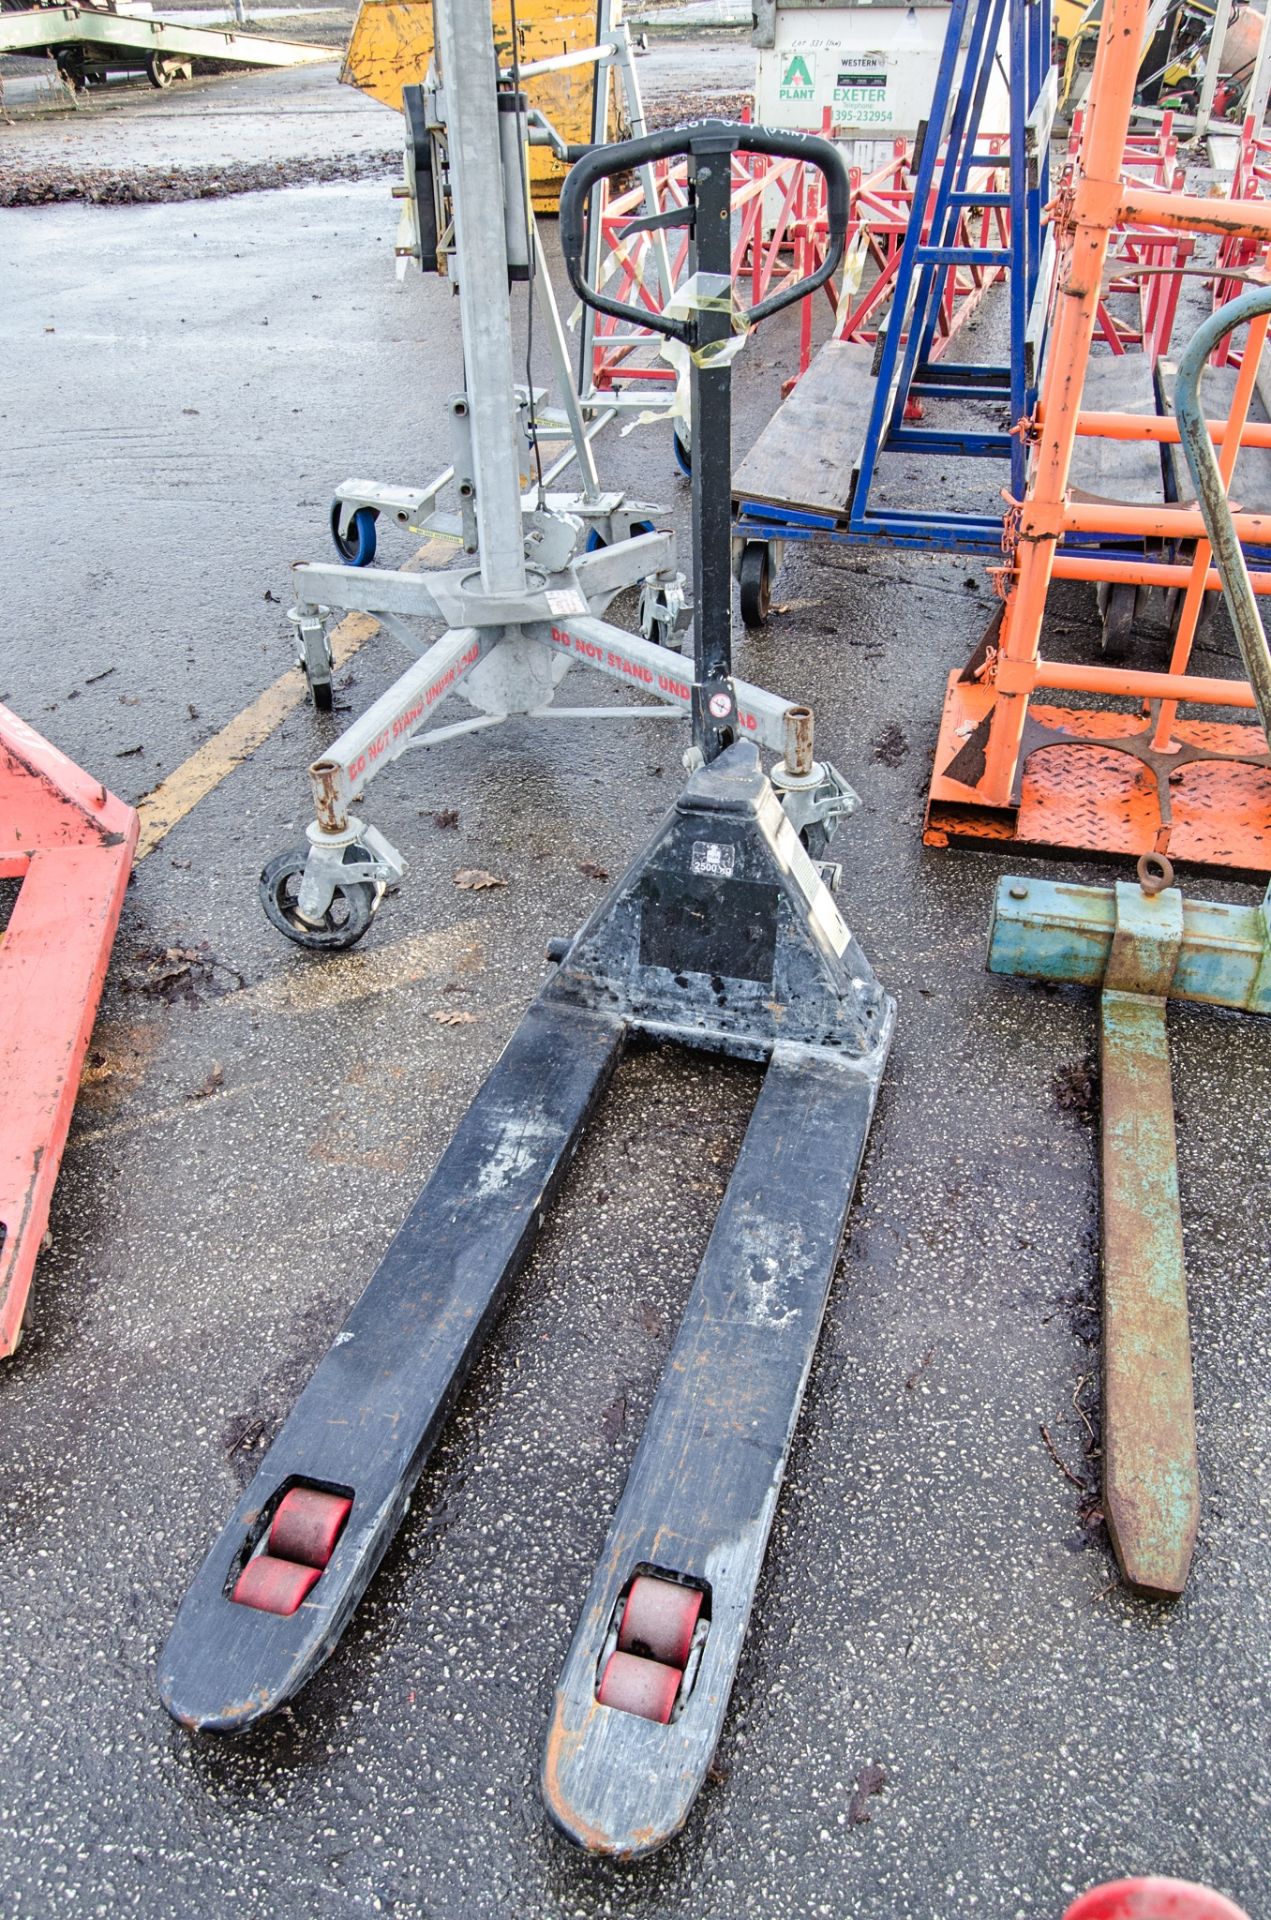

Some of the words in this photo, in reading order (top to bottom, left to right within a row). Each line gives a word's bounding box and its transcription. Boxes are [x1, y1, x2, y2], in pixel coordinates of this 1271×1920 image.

[841, 59, 877, 67] WESTERN
[782, 55, 813, 85] A
[779, 89, 815, 99] PLANT
[833, 88, 886, 101] EXETER
[551, 626, 571, 647] DO
[575, 638, 603, 662] NOT
[607, 652, 653, 684] STAND
[658, 675, 692, 700] UND
[348, 754, 366, 782] DO
[368, 729, 389, 763] NOT
[392, 700, 425, 737] STAND
[694, 861, 717, 873] 2500
